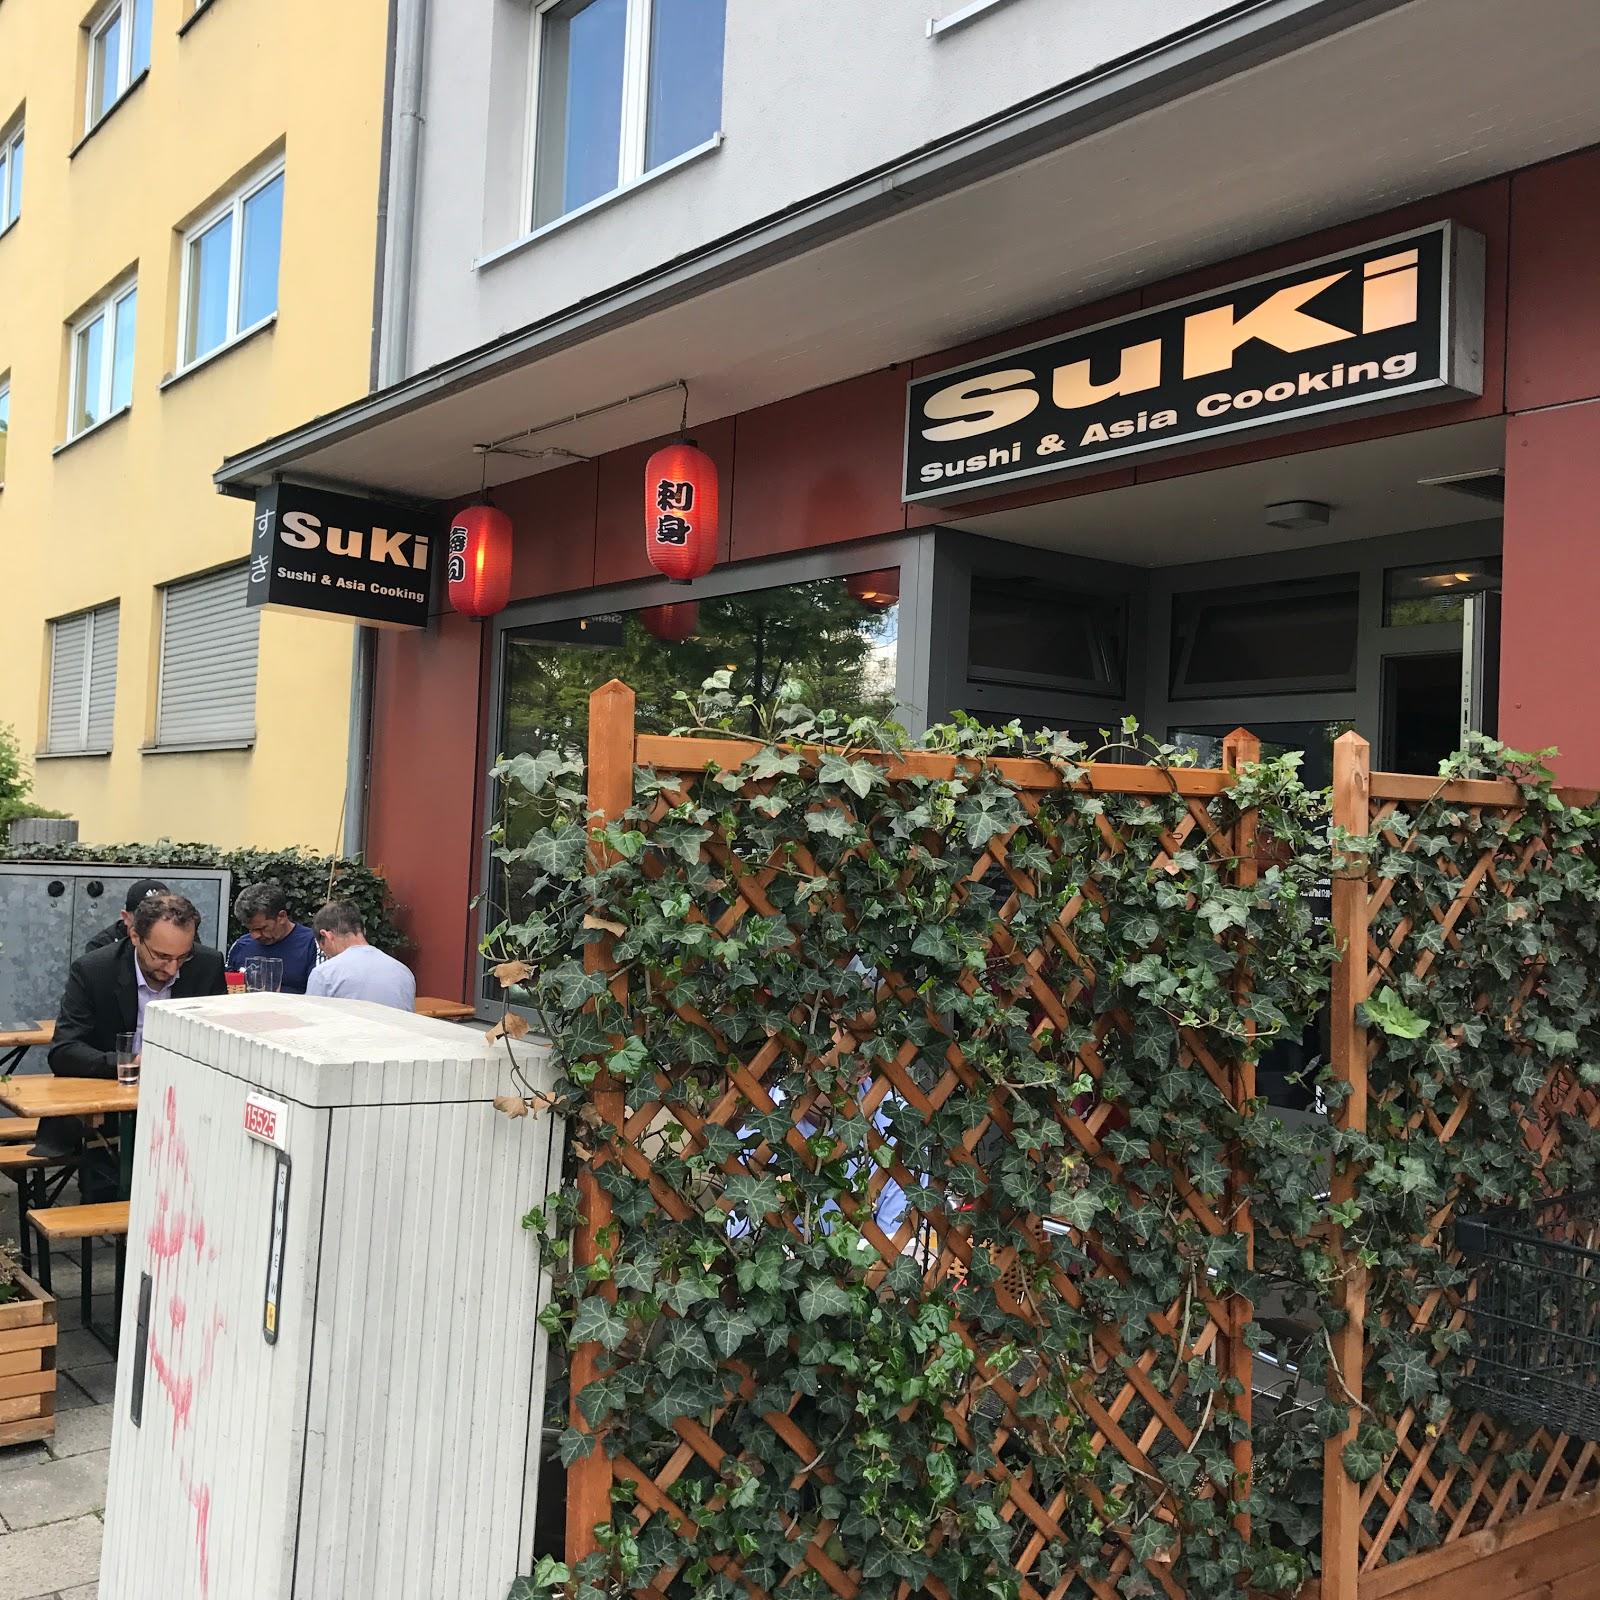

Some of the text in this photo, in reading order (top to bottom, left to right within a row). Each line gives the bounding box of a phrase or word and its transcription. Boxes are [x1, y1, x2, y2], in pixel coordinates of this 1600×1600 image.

[921, 247, 1419, 443] SuKi
[919, 350, 1418, 484] Sushi & Asia Cooking
[251, 508, 275, 584] すき
[279, 510, 429, 571] SuKi
[277, 566, 425, 603] Sushi & Asia Cooking
[246, 1104, 276, 1138] 15525
